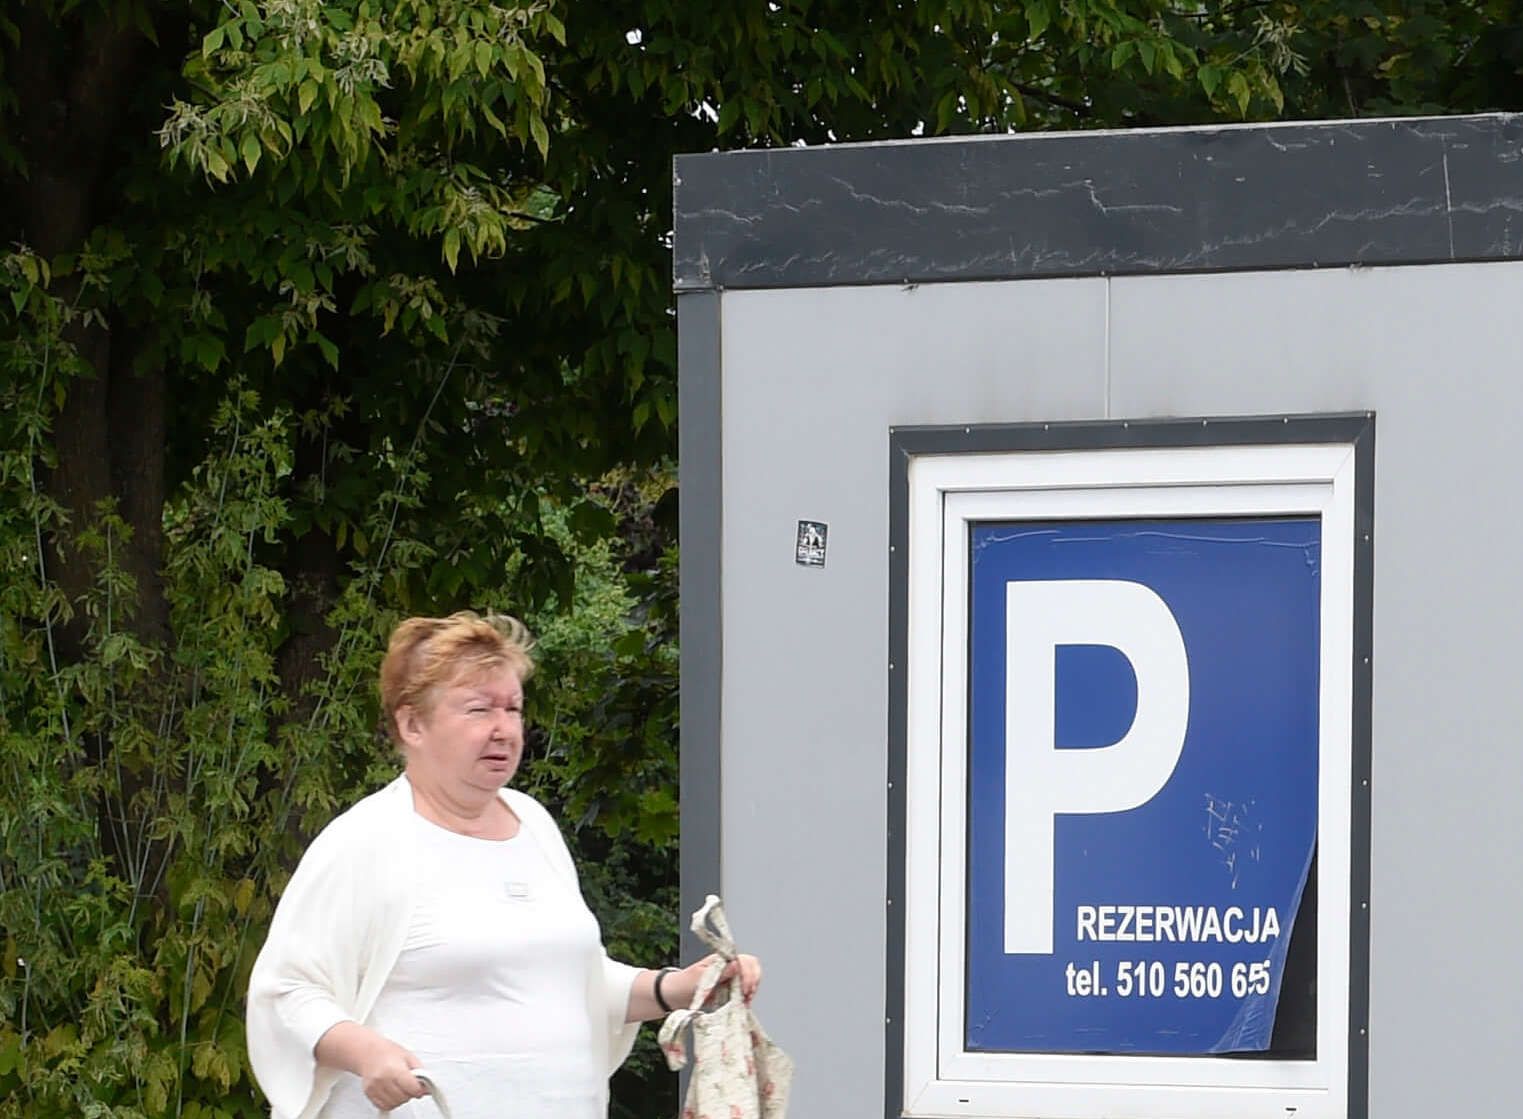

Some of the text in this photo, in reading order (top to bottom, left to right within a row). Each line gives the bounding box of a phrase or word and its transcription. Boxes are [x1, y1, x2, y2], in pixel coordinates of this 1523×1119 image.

[1004, 579, 1191, 955] P
[1077, 905, 1280, 943] REZERWACJA
[1065, 961, 1107, 996] tel.
[1116, 961, 1165, 997] 510
[1174, 962, 1223, 998] 560
